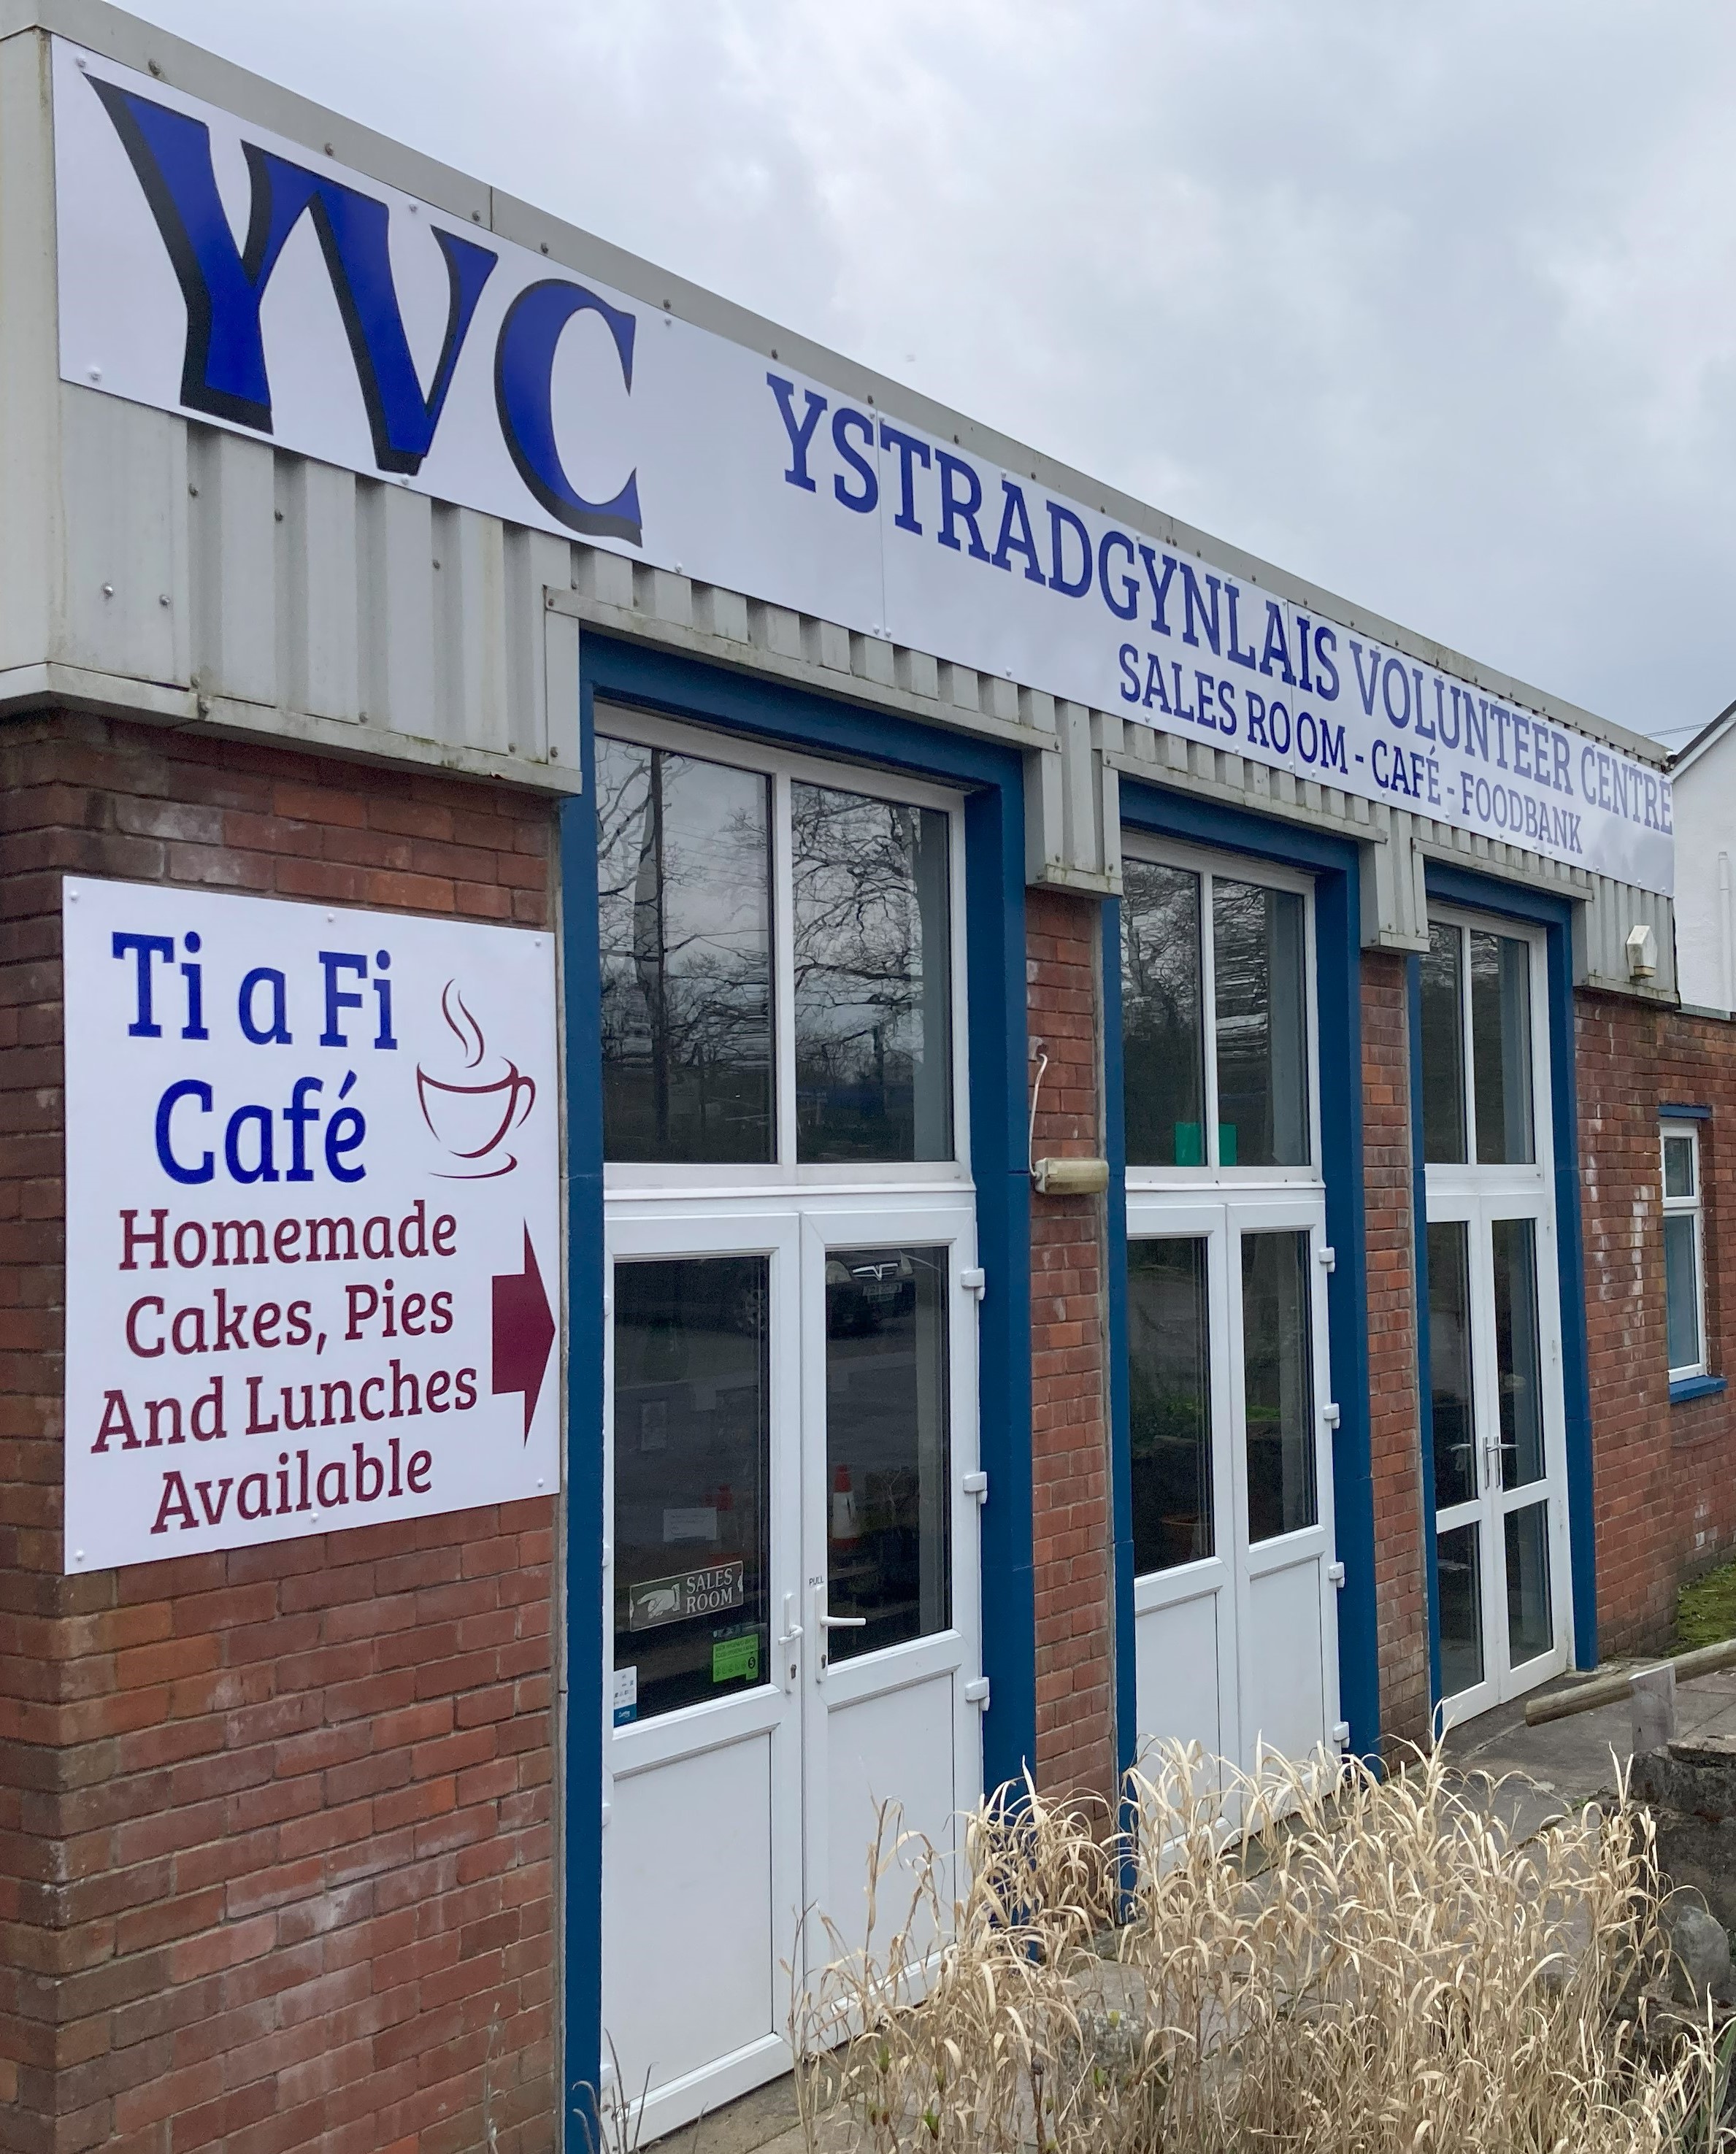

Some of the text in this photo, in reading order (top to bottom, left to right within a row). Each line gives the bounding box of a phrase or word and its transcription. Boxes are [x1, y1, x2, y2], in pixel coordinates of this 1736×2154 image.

[82, 72, 643, 548] YVC
[766, 371, 1673, 836] YSTRADGYNLAIS VOLUNTEER CENTRE
[1119, 643, 1237, 736] SALES
[1245, 690, 1349, 775] ROOM
[1371, 739, 1441, 807] CAFÉ
[1460, 770, 1583, 854] FOODBANK
[112, 931, 398, 1050] Ti a Fi
[154, 1069, 367, 1185] Café
[119, 1199, 457, 1271] Homemade
[126, 1279, 453, 1358] Cakes, Pies
[91, 1358, 477, 1454] And Lunches
[150, 1437, 433, 1534] Available
[685, 1568, 733, 1594] SALES
[685, 1587, 733, 1615] ROOM
